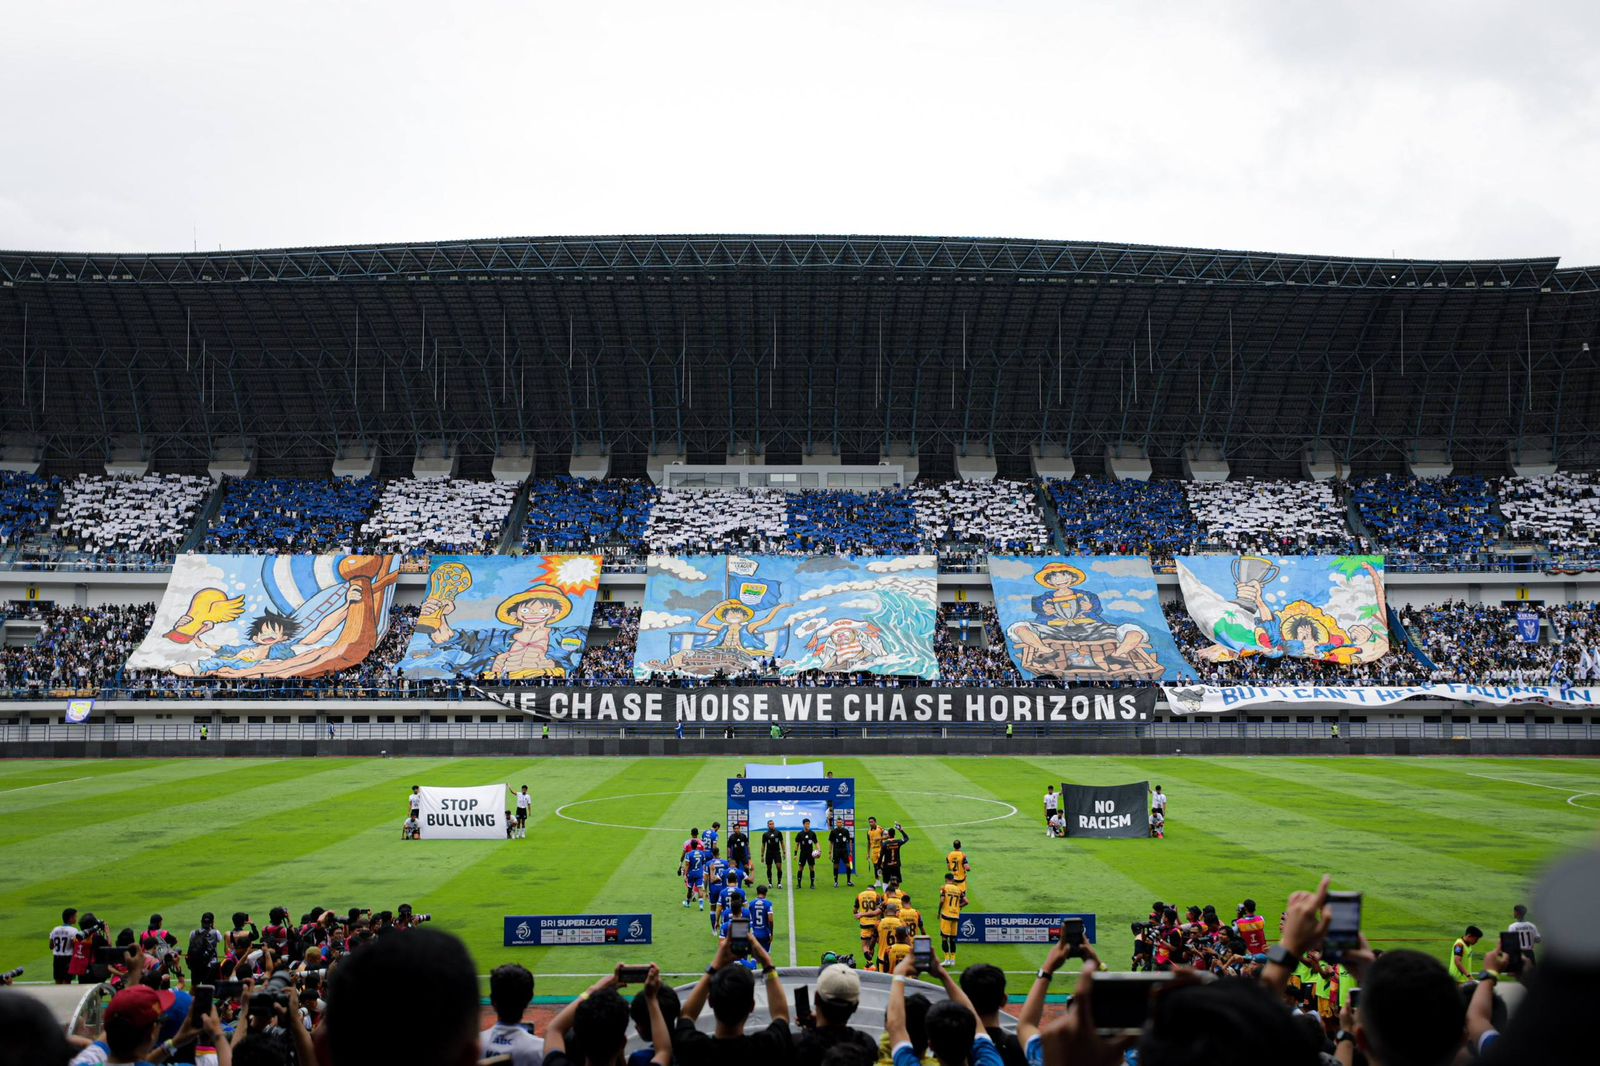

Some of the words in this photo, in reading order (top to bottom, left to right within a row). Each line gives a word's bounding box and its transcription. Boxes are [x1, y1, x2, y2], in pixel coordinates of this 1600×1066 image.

[1559, 688, 1592, 702] IN
[549, 692, 663, 721] CHASE
[781, 693, 832, 721] WE
[843, 693, 953, 722] CHASE
[965, 694, 1147, 722] HORIZONS.
[751, 785, 766, 793] BRI
[441, 798, 478, 811] STOP
[1095, 800, 1115, 813] NO
[427, 814, 495, 827] BULLYING
[1079, 814, 1131, 829] RACISM
[695, 857, 701, 870] 7
[947, 893, 961, 907] 77
[540, 919, 556, 928] BRI
[755, 909, 763, 925] 5
[984, 917, 999, 926] BRI
[886, 930, 895, 946] 6
[1520, 931, 1532, 947] 11
